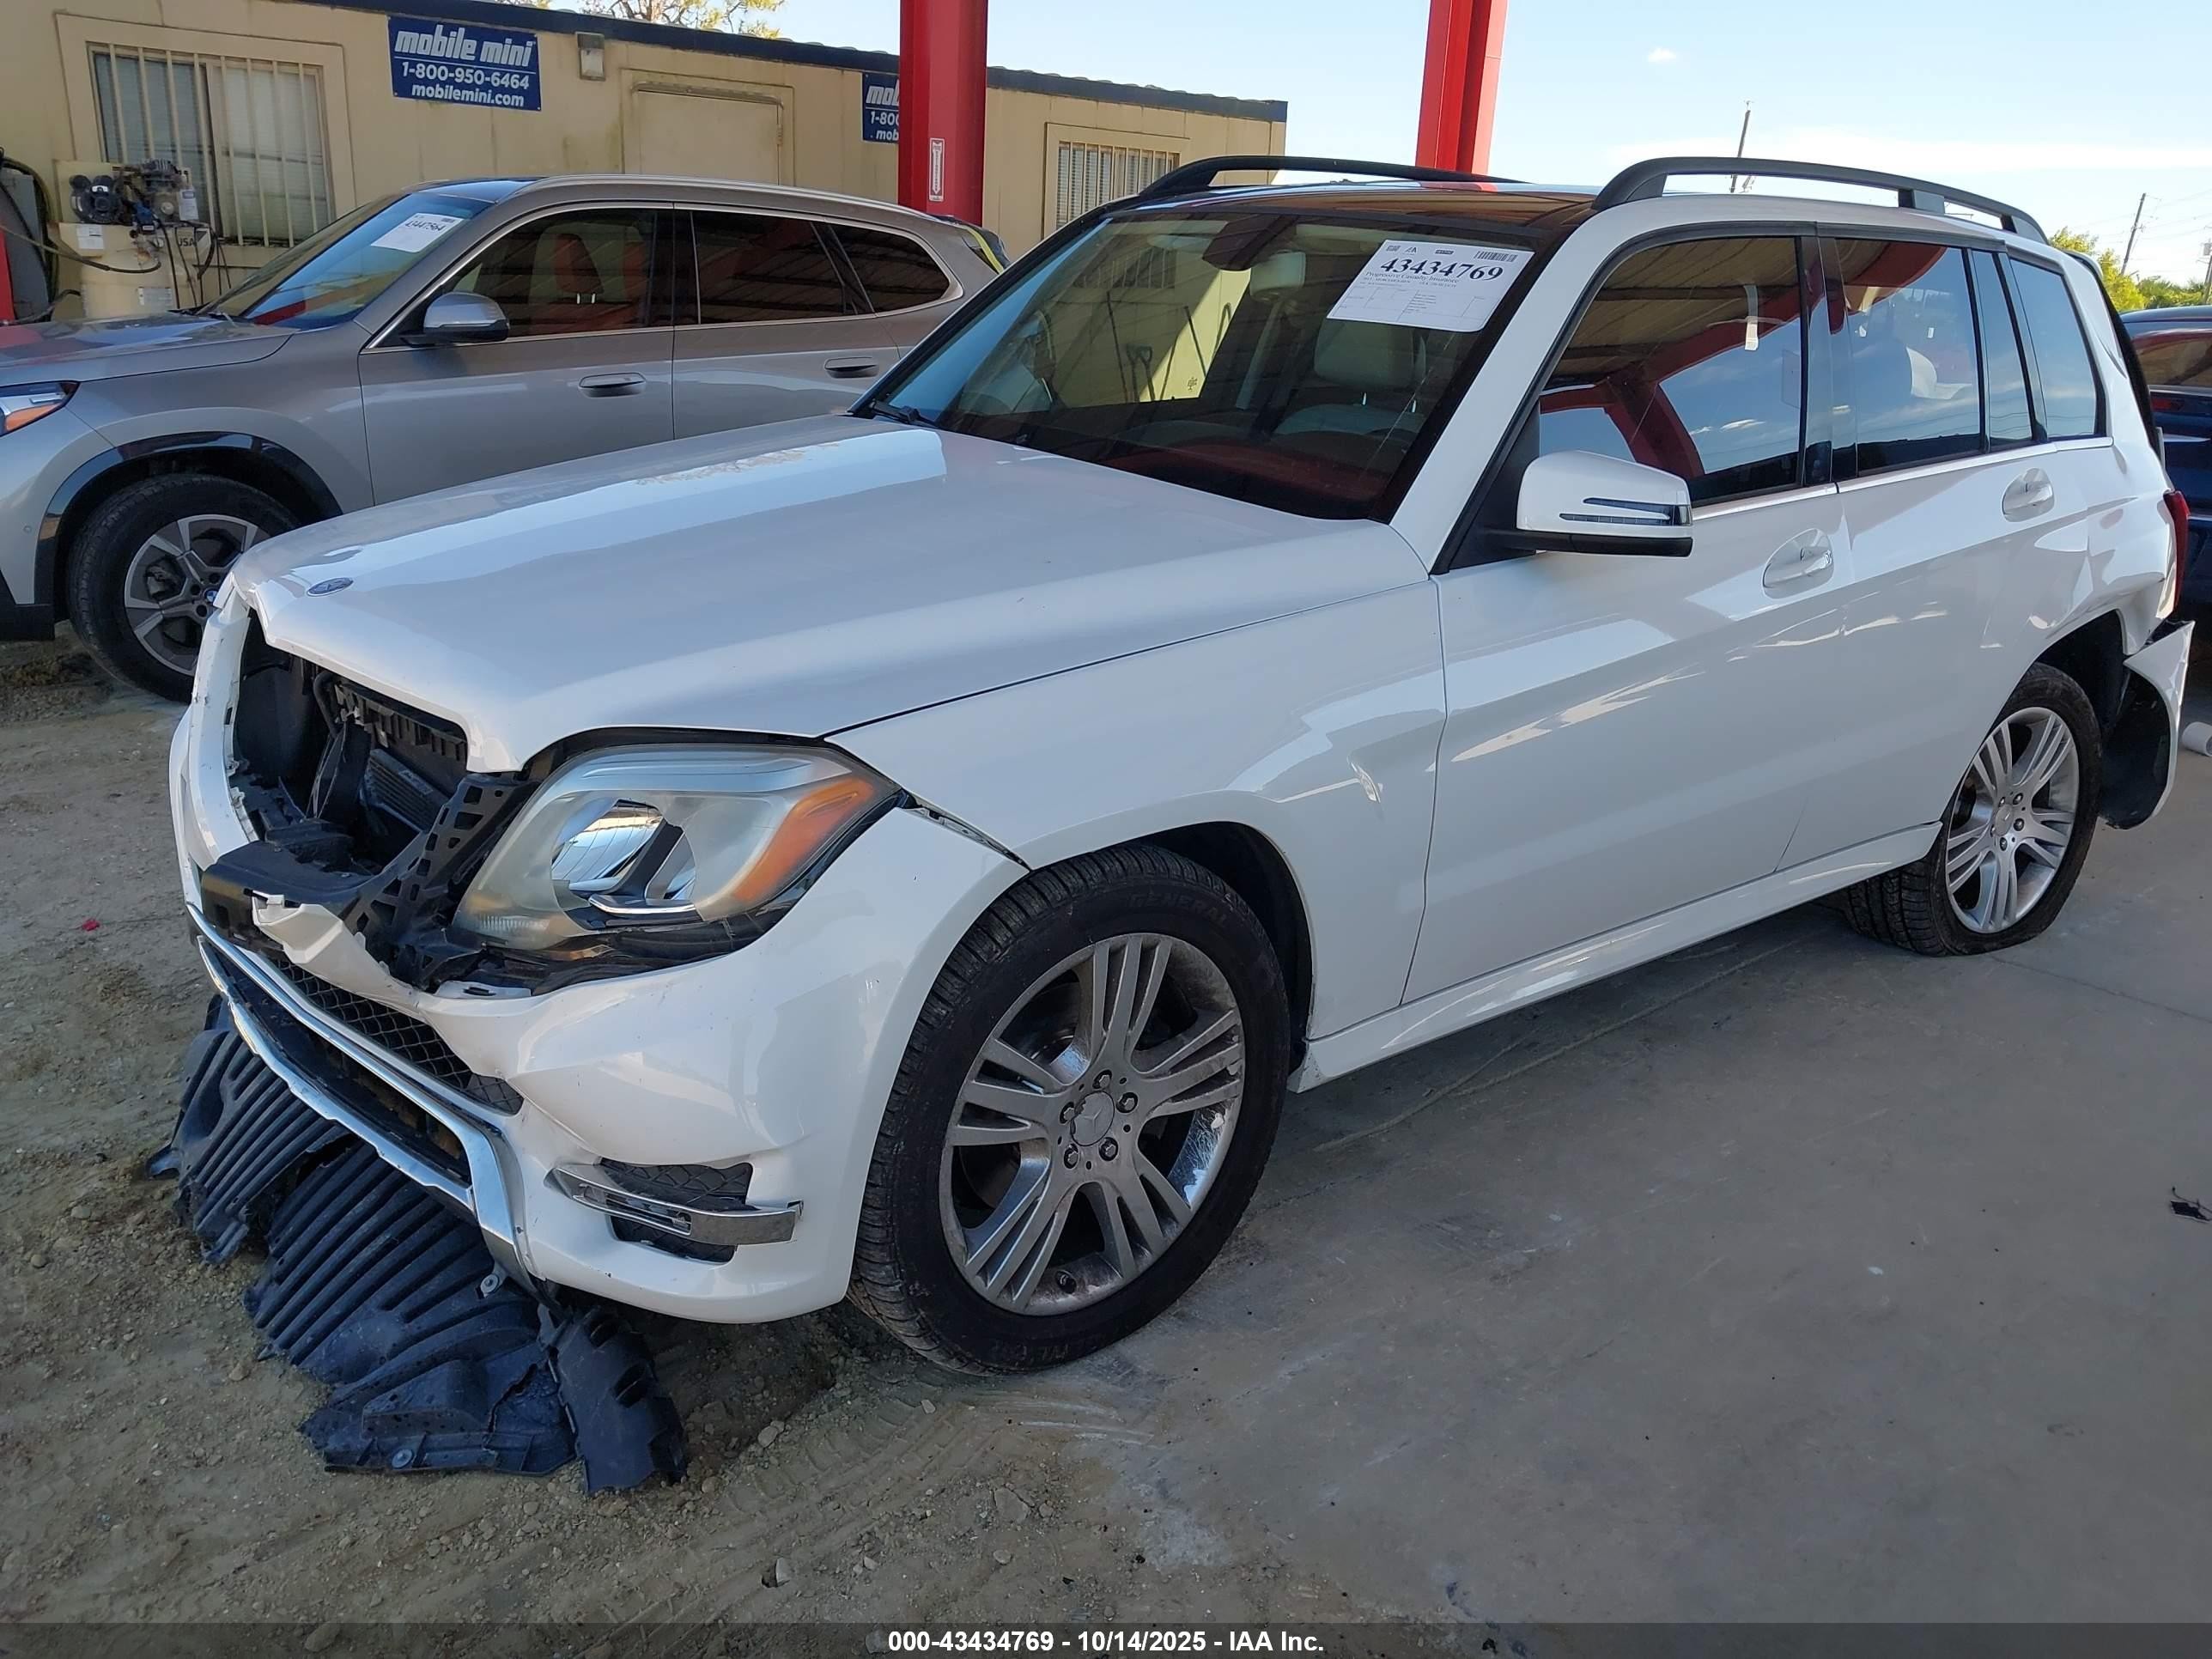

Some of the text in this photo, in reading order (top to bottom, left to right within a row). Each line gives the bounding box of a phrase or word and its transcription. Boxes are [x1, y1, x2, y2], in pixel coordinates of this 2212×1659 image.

[394, 24, 534, 67] mobile mini
[402, 61, 530, 90] 1-800-950-6464
[411, 83, 525, 106] mobilemini.com
[1380, 258, 1504, 281] 43434769
